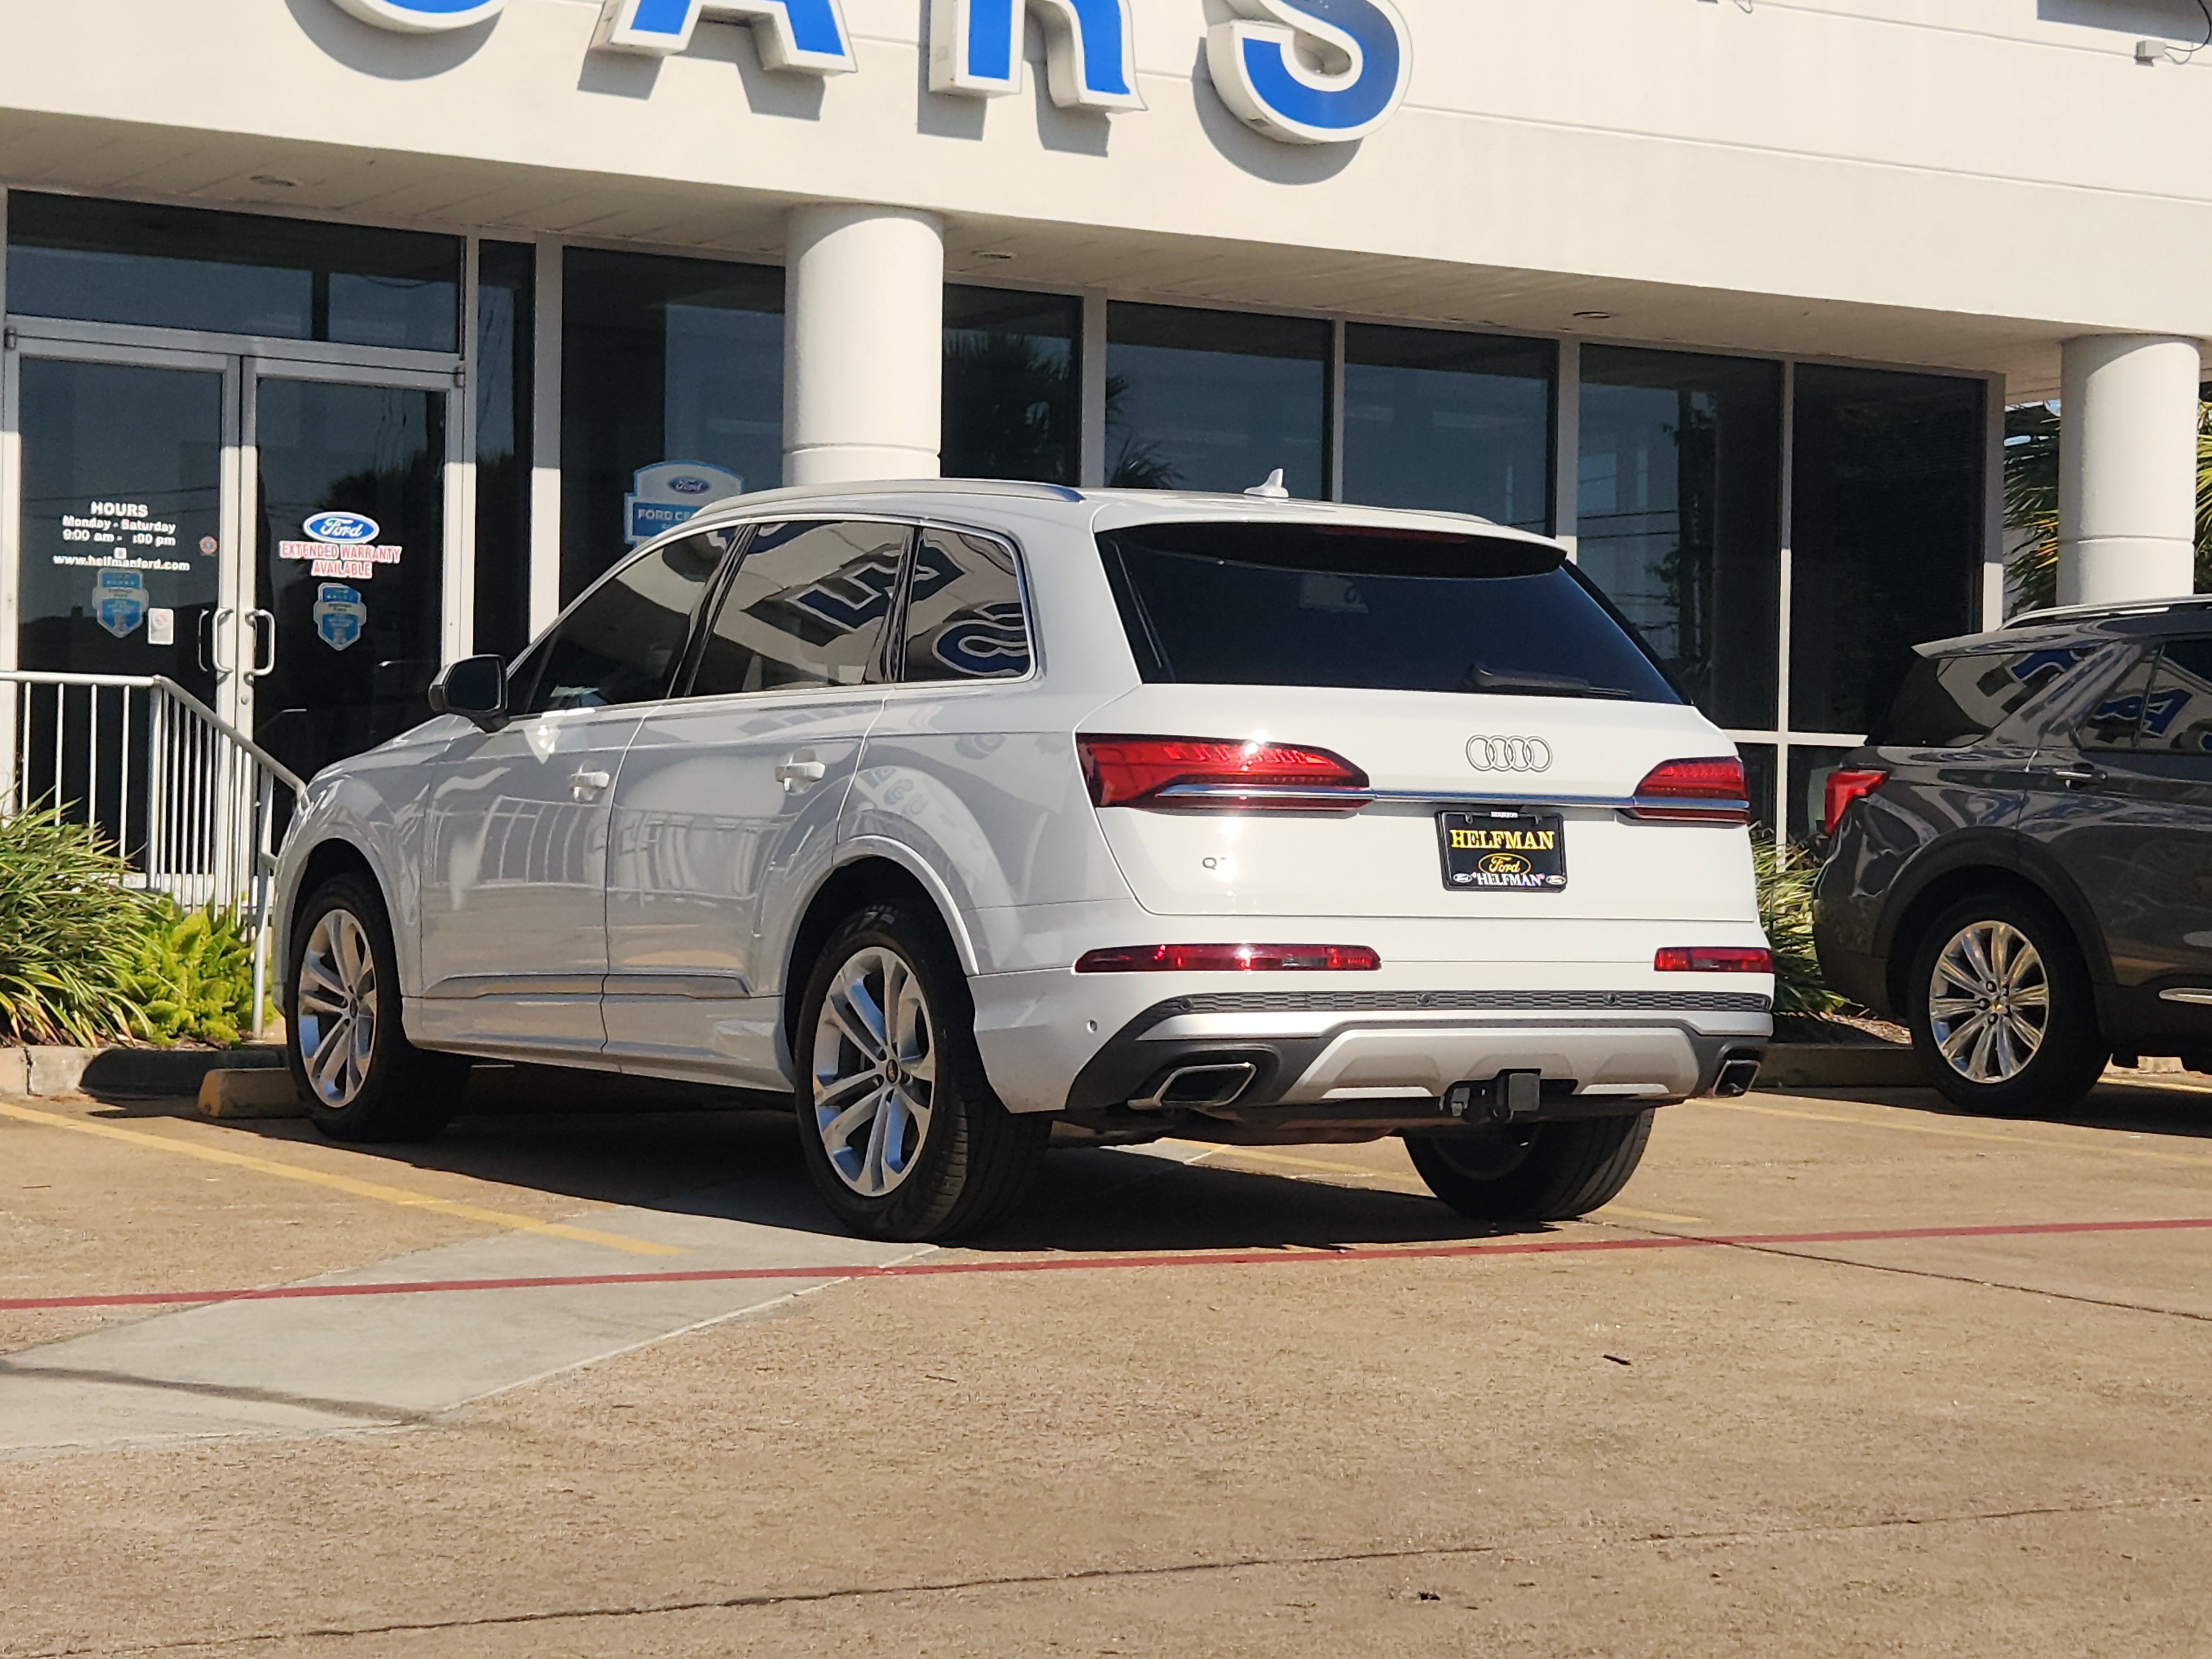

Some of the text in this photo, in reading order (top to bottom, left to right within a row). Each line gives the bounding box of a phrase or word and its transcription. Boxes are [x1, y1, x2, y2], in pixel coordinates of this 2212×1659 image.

[90, 501, 148, 517] HOURS
[638, 508, 672, 520] FORD
[62, 515, 111, 531] Monday
[121, 519, 176, 535] Saturday
[320, 517, 364, 537] Ford
[63, 529, 90, 541] 9:00
[93, 532, 114, 542] am
[155, 536, 176, 547] pm
[281, 542, 401, 562] EXTENDED WARRANTY
[53, 555, 190, 571] www.helfmanford.com
[312, 561, 371, 578] AVAILABLE
[1449, 830, 1555, 850] HELFMAN
[1488, 856, 1521, 873] Ford
[1477, 872, 1541, 886] HELFMAN
